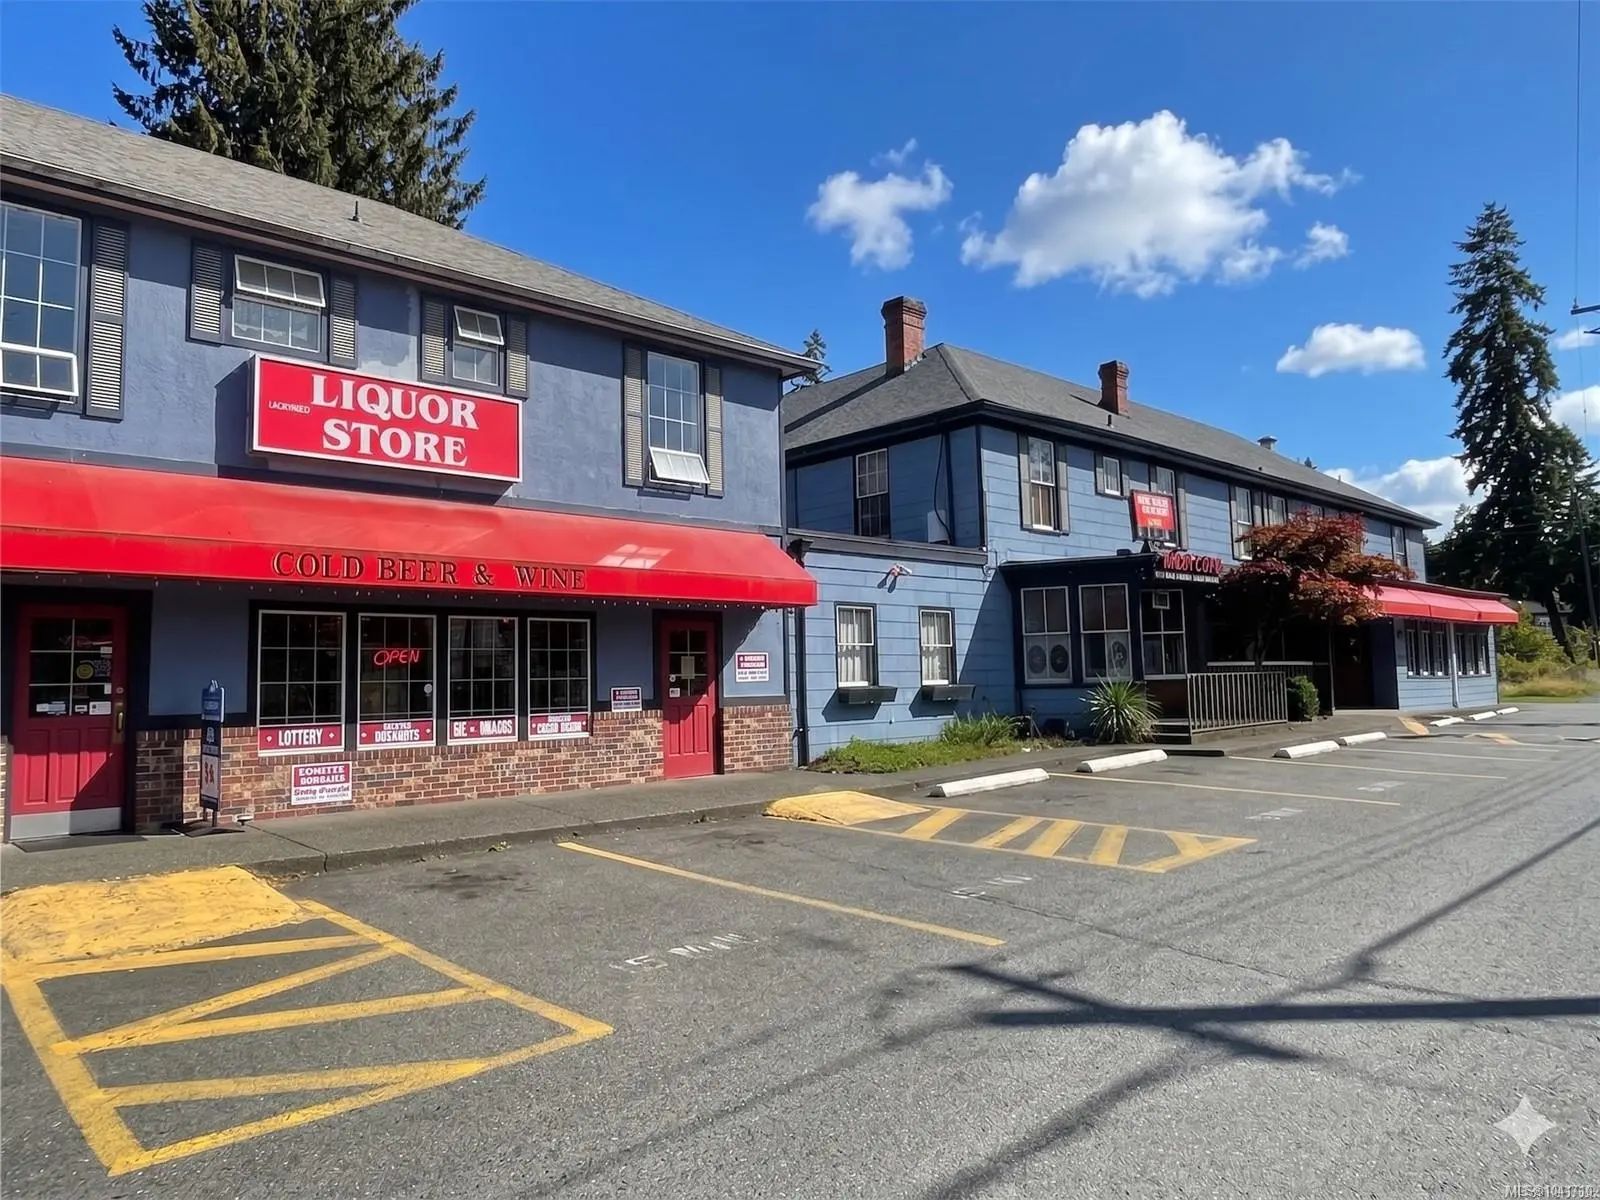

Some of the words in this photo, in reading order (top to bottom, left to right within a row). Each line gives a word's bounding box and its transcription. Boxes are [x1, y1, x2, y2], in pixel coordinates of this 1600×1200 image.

[311, 374, 479, 430] LIQUOR
[322, 419, 468, 467] STORE
[272, 551, 364, 579] COLD
[377, 556, 459, 585] BEER
[473, 563, 495, 586] &
[513, 564, 586, 590] WINE
[374, 650, 420, 666] OPEN
[278, 728, 323, 746] LOTTERY
